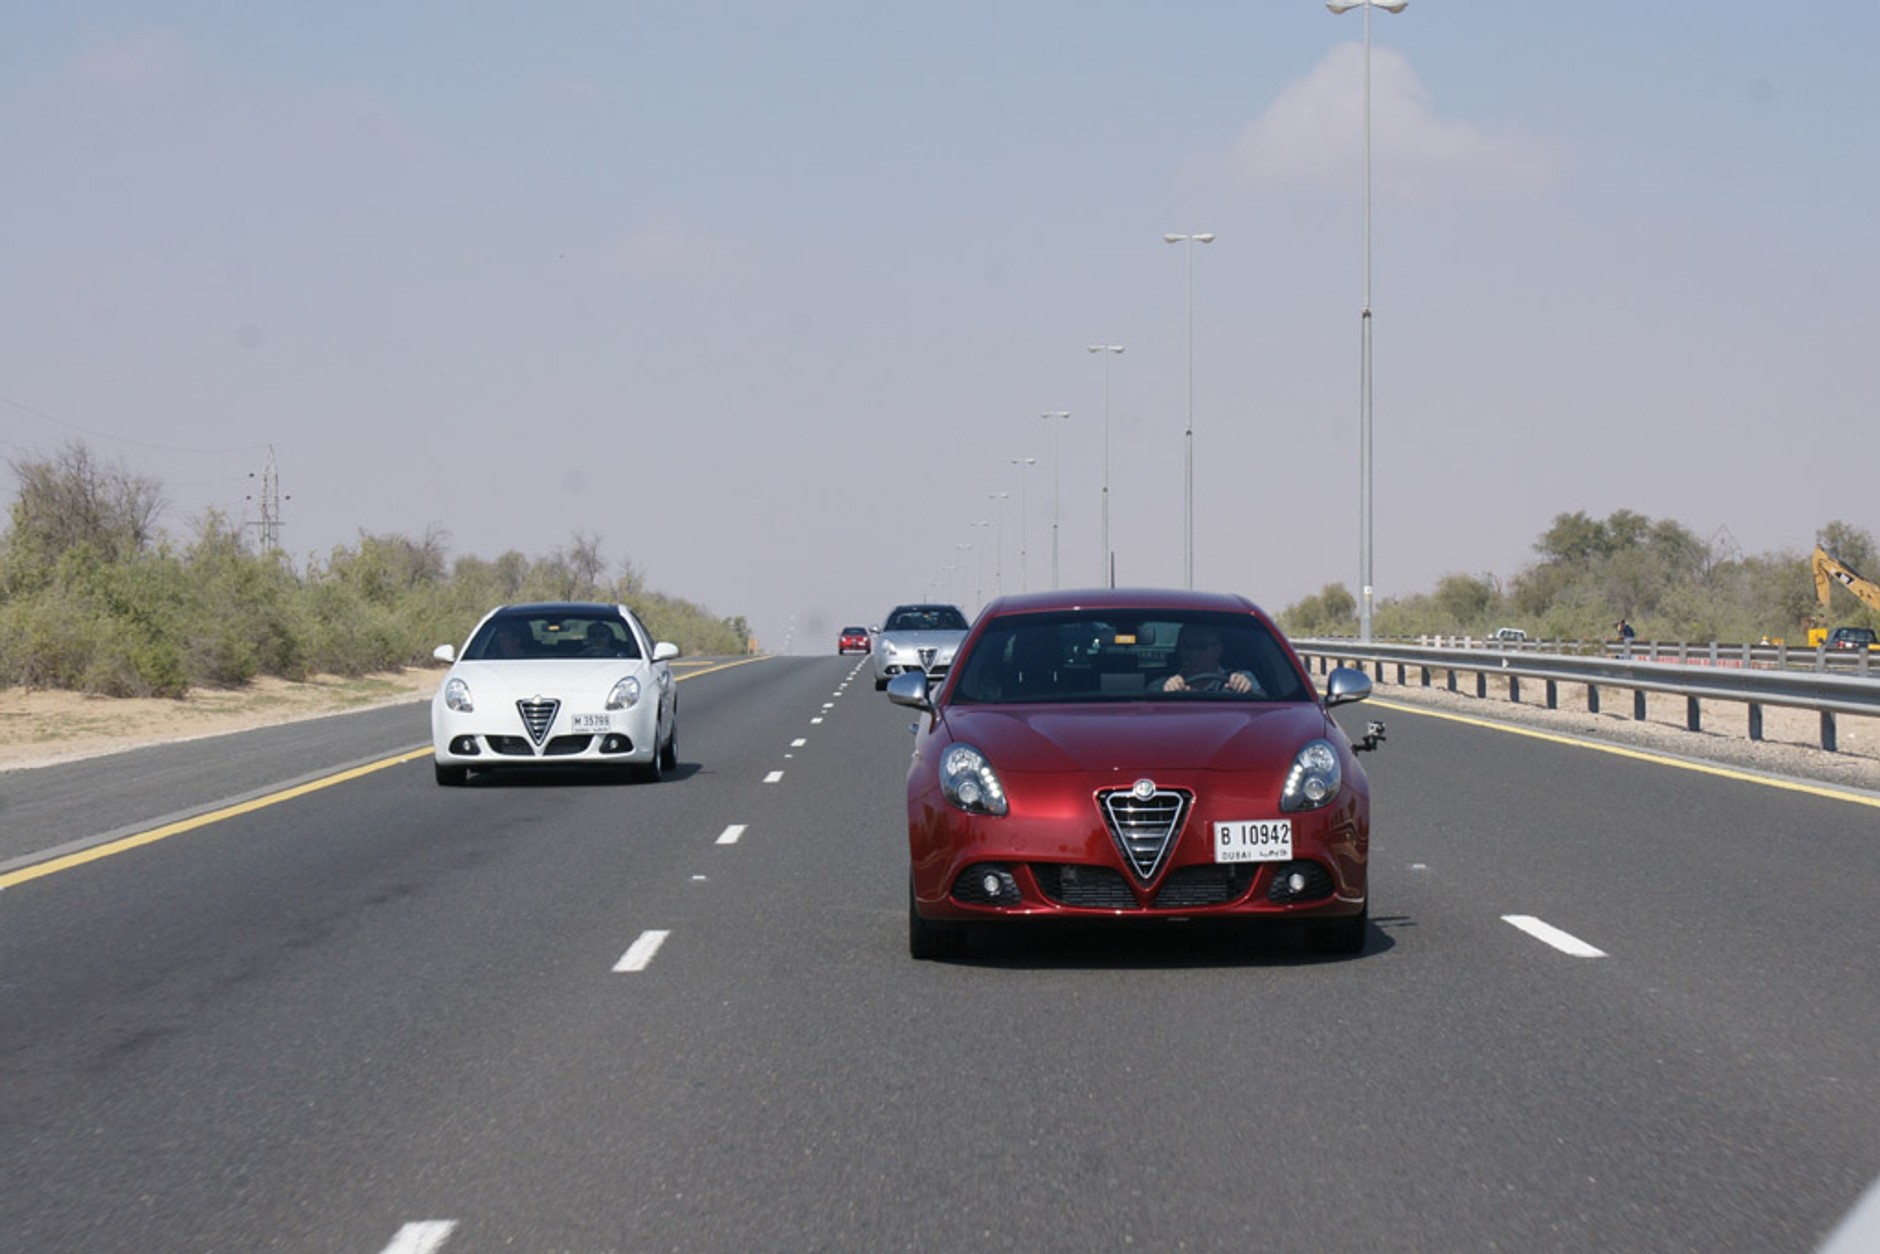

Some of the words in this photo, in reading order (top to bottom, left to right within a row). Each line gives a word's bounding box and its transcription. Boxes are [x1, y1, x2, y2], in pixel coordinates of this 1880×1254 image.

[1221, 827, 1231, 845] B
[1241, 823, 1289, 845] 10942
[1222, 851, 1251, 860] DUBAI
